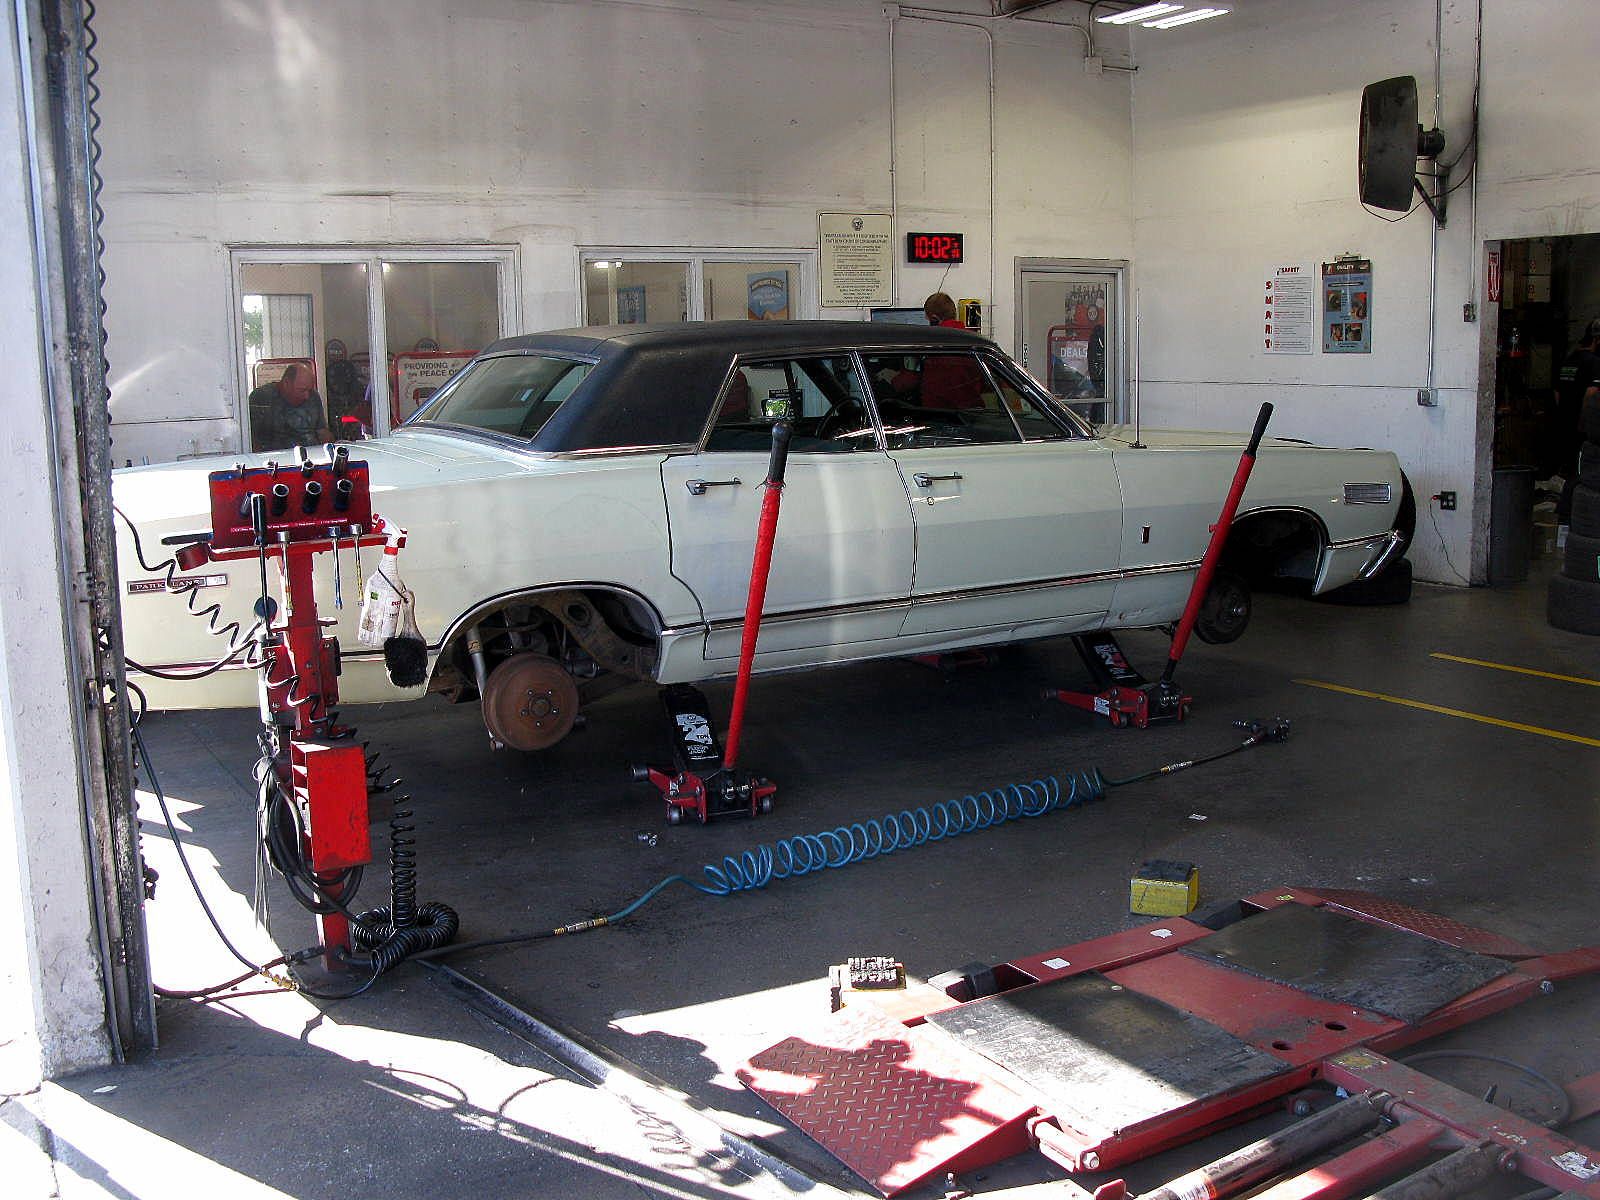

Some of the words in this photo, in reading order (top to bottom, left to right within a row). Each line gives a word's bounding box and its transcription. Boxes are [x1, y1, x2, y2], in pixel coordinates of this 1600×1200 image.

[915, 236, 951, 259] 10:02
[1060, 347, 1088, 358] DEALS
[135, 582, 166, 590] PARK
